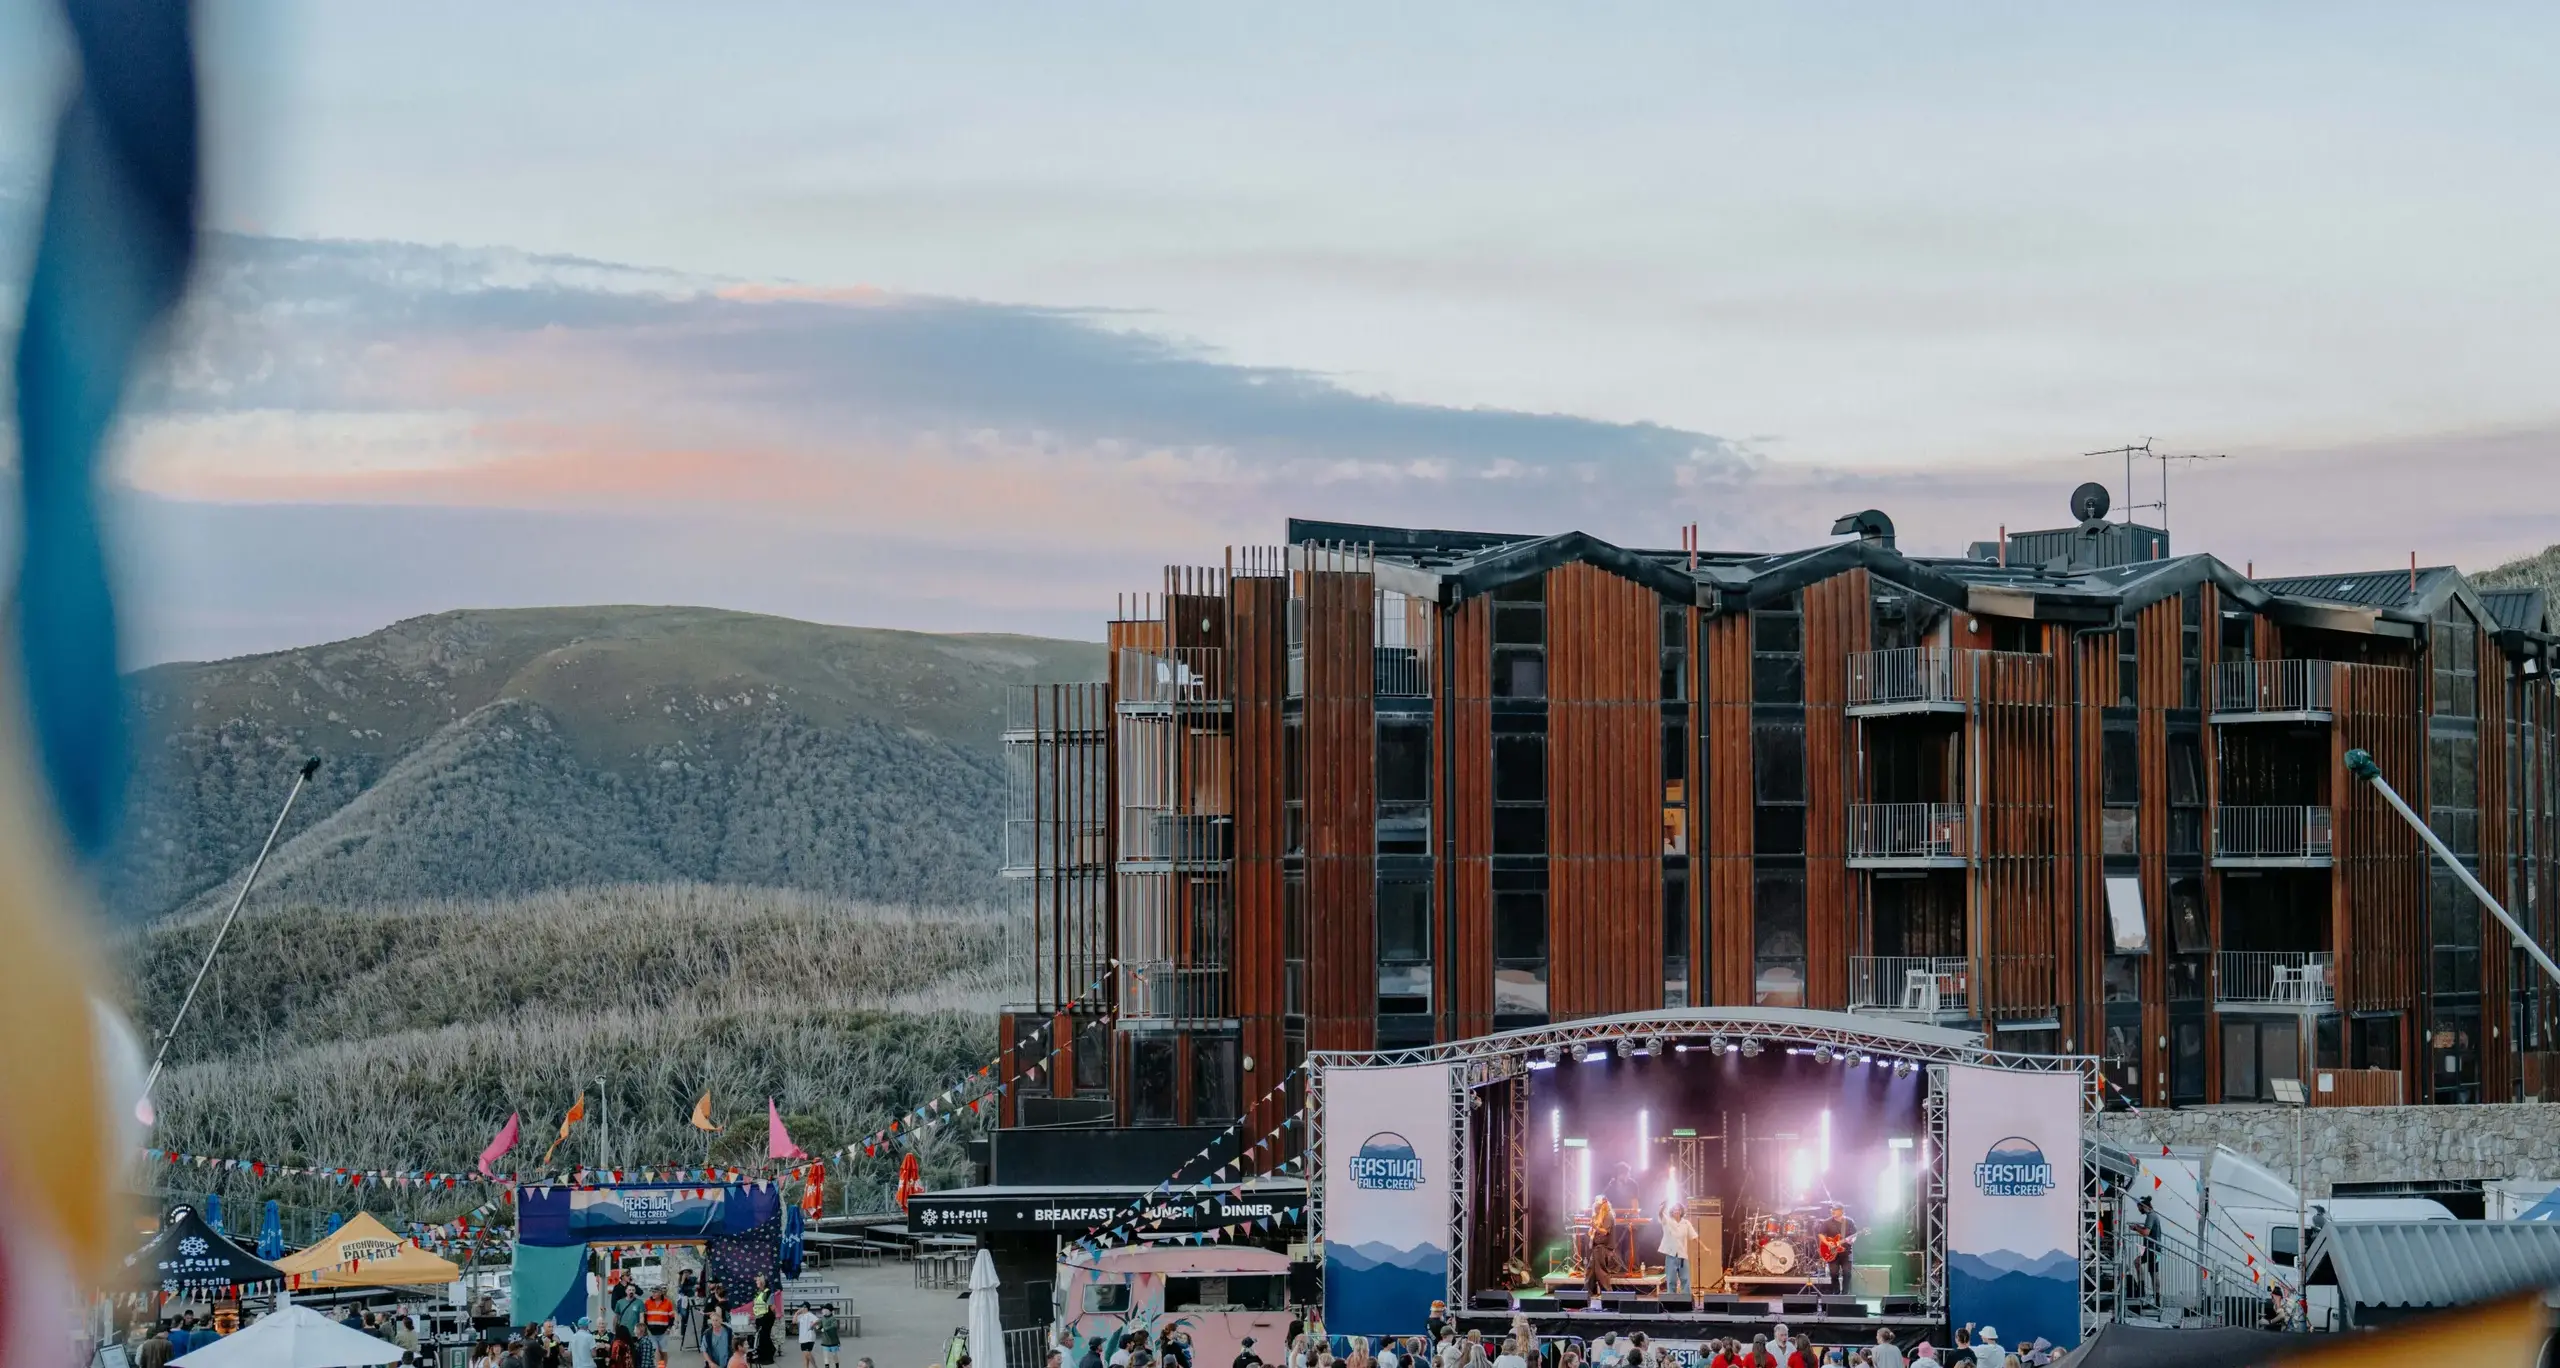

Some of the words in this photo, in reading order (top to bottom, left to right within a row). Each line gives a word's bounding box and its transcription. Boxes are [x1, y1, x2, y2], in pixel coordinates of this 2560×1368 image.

[1358, 1178, 1384, 1189] FALLS
[1385, 1178, 1415, 1190] CREEK
[1984, 1184, 2011, 1196] FALLS
[2013, 1184, 2044, 1196] CREEK
[942, 1209, 988, 1220] St.Falls
[1034, 1207, 1116, 1221] BREAKFAST
[1221, 1204, 1273, 1217] DINNER
[158, 1258, 231, 1270] St.Falls
